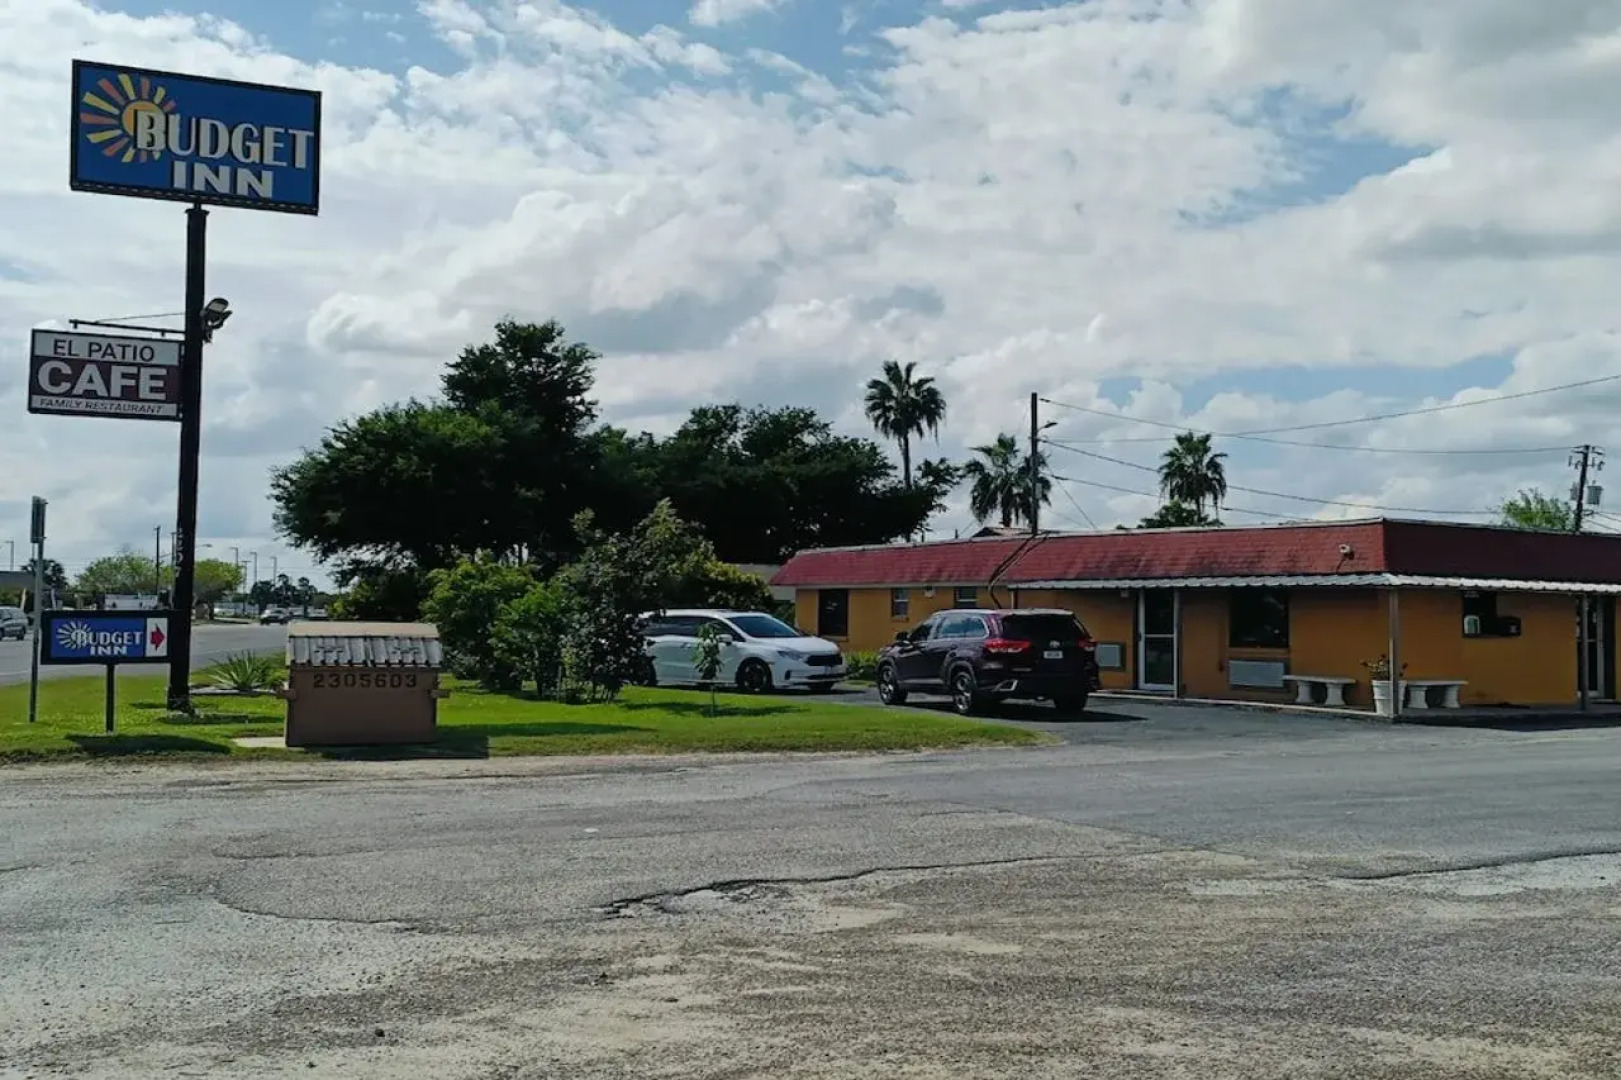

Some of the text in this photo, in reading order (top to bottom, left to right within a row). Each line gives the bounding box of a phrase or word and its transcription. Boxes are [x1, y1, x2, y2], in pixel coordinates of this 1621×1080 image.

[135, 110, 314, 168] BUDGET
[172, 161, 273, 198] INN
[54, 339, 154, 361] EL PATIO
[38, 361, 167, 400] CAFE
[40, 398, 162, 414] FAMILY RESTAURANT
[76, 630, 143, 645] BUDGET
[90, 646, 127, 655] INN
[313, 673, 417, 688] 2305603
